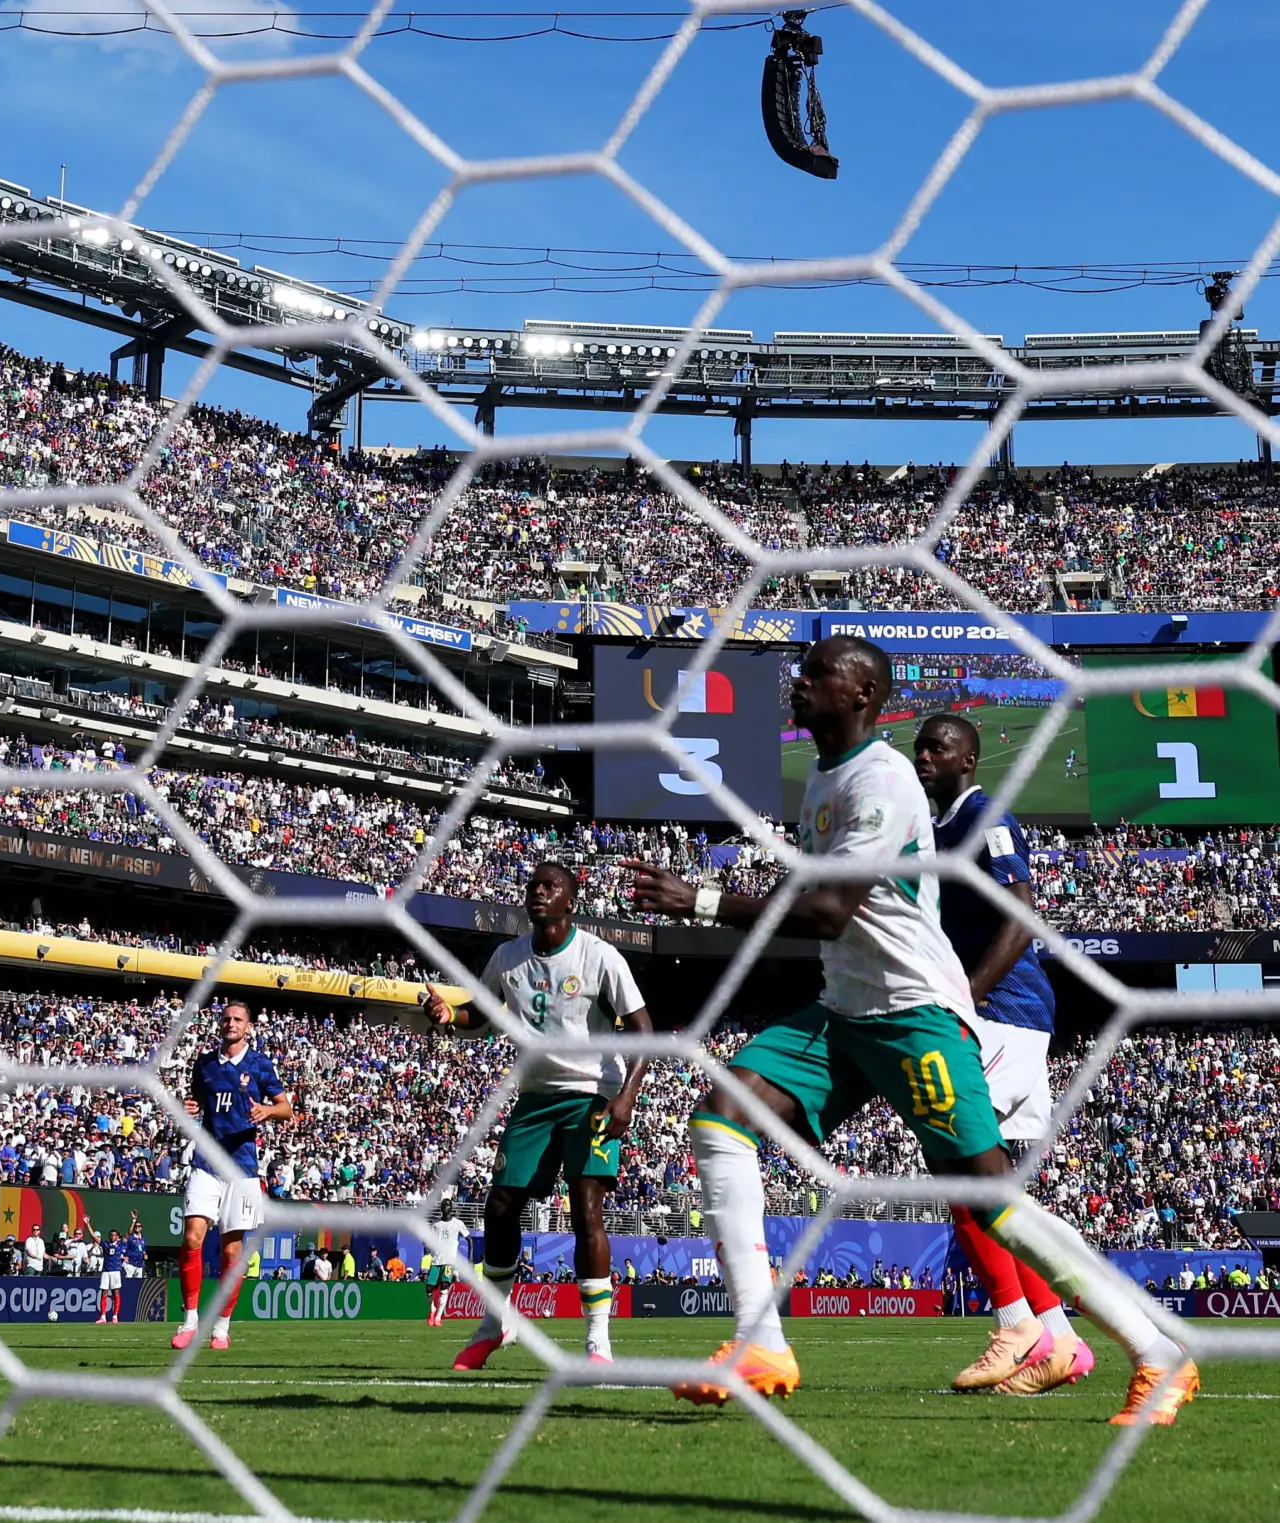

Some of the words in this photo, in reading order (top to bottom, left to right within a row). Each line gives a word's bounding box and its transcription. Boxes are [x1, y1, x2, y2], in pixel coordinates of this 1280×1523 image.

[406, 622, 464, 644] JERSEY
[830, 624, 867, 638] FIFA
[868, 625, 929, 639] WORLD
[930, 625, 964, 639] CUP
[923, 668, 939, 677] SEN
[658, 737, 723, 795] 3
[1156, 742, 1216, 799] 1
[26, 840, 68, 862] YORK
[70, 849, 104, 867] NEW
[106, 853, 163, 876] JERSEY
[599, 926, 630, 943] YORK
[531, 993, 548, 1027] 9
[901, 1050, 956, 1116] 10
[215, 1092, 233, 1113] 14
[241, 1196, 253, 1215] 14
[691, 1258, 719, 1277] FIFA
[10, 1287, 48, 1312] CUP
[252, 1281, 361, 1319] aramco
[810, 1291, 850, 1314] Lenovo
[868, 1291, 916, 1315] Lenovo
